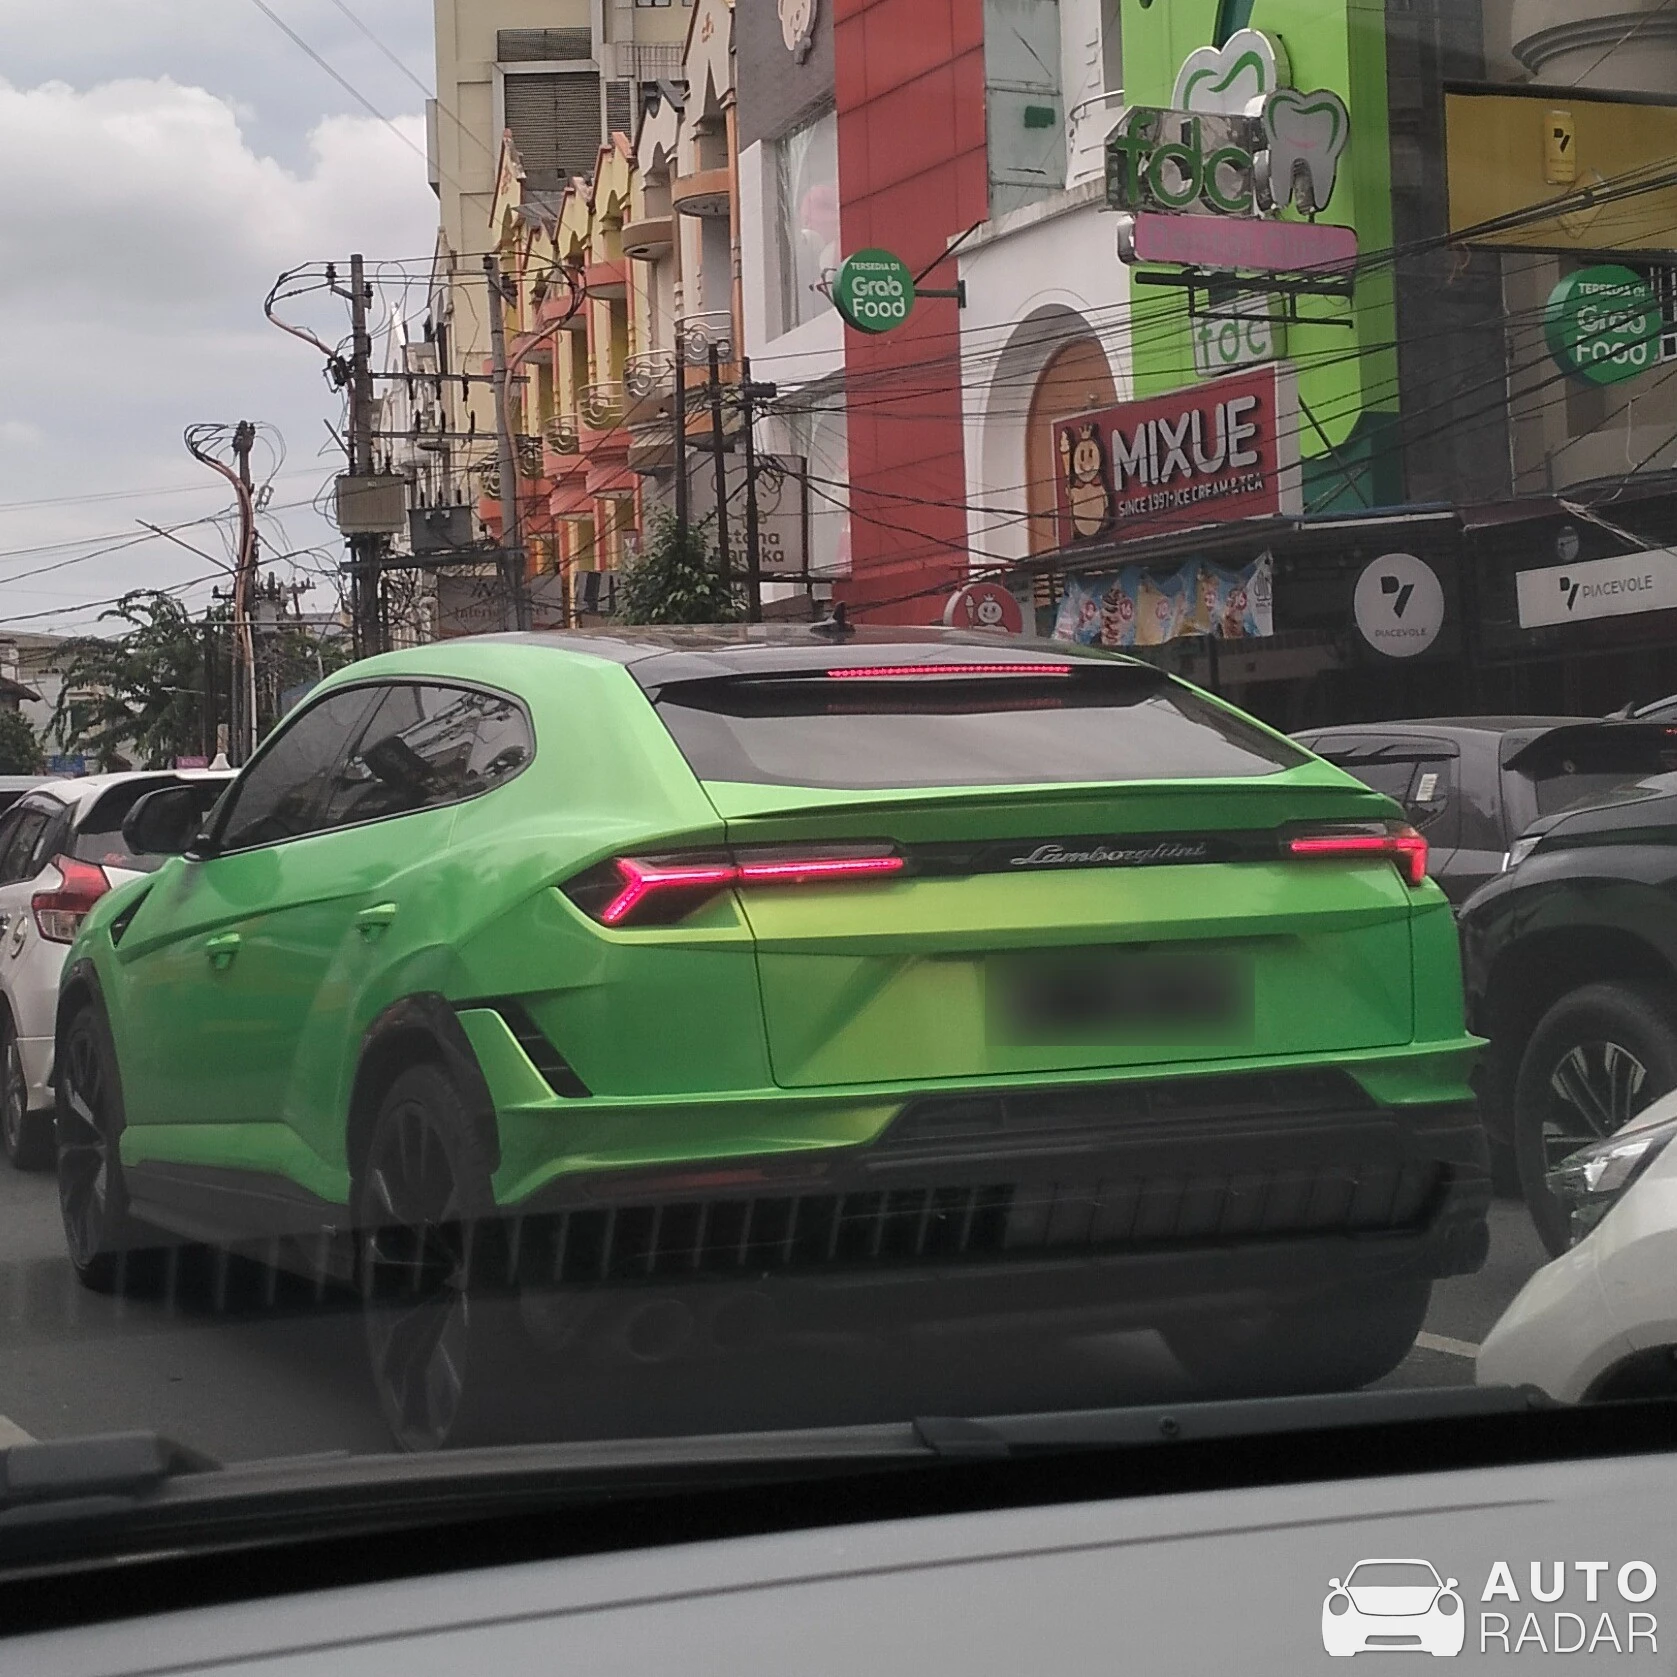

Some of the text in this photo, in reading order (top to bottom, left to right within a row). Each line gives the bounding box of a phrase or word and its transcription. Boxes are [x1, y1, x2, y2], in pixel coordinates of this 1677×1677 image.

[1115, 111, 1253, 212] fdc
[850, 262, 900, 271] TERSEDIA DI
[851, 275, 903, 297] Grab
[852, 297, 906, 318] Food
[1577, 335, 1647, 365] Food
[1111, 395, 1258, 491] MIXUE
[1118, 498, 1146, 517] SINCE
[1582, 575, 1653, 599] PIACEVOLE
[1009, 842, 1207, 865] Lamborghini
